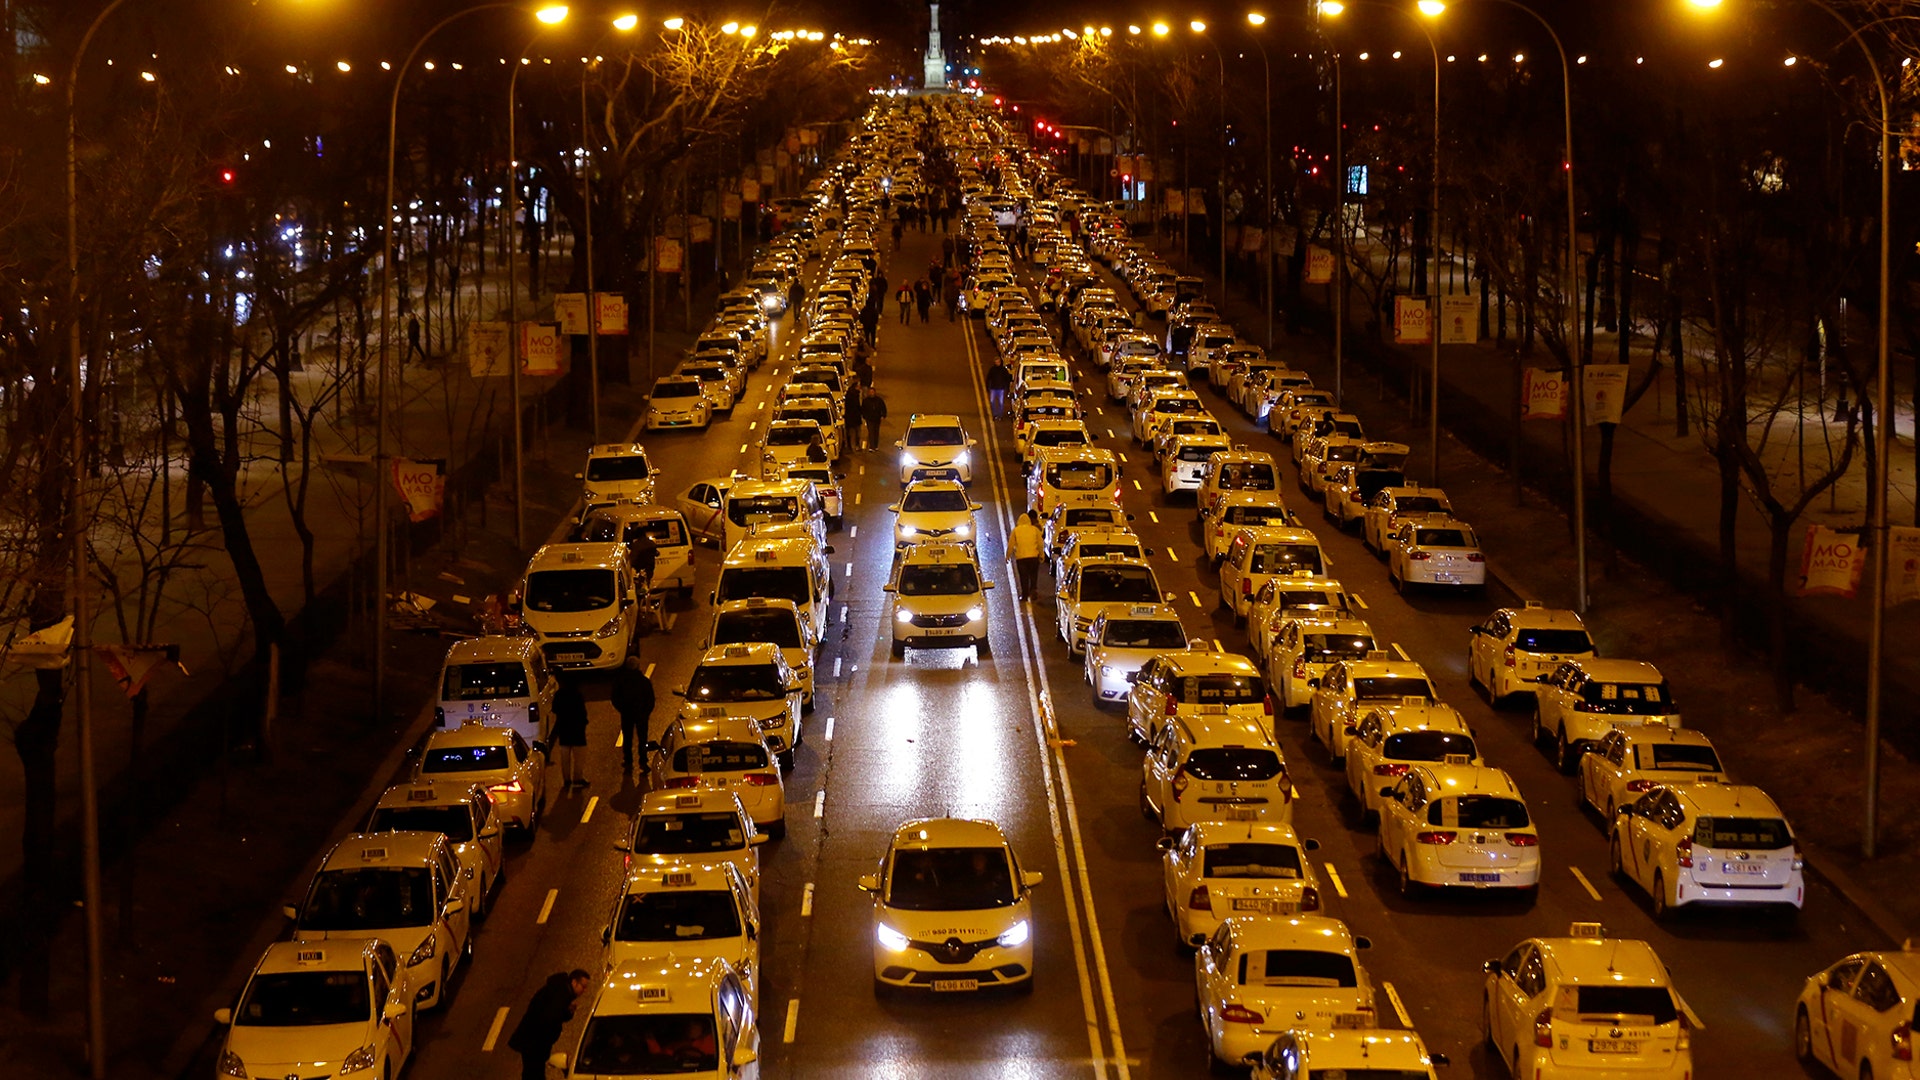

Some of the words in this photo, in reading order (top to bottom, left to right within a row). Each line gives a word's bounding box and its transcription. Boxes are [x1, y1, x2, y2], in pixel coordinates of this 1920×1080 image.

[603, 303, 621, 311] MO
[1403, 307, 1424, 319] MO
[530, 335, 554, 347] MO
[530, 347, 554, 355] MAD
[1532, 379, 1559, 391] MO
[1531, 391, 1558, 400] MAD
[403, 472, 433, 485] MO
[1814, 543, 1852, 559] MO
[1812, 559, 1849, 569] MAD
[302, 951, 318, 961] TAXI
[960, 980, 976, 989] KRN
[1264, 1007, 1271, 1017] V
